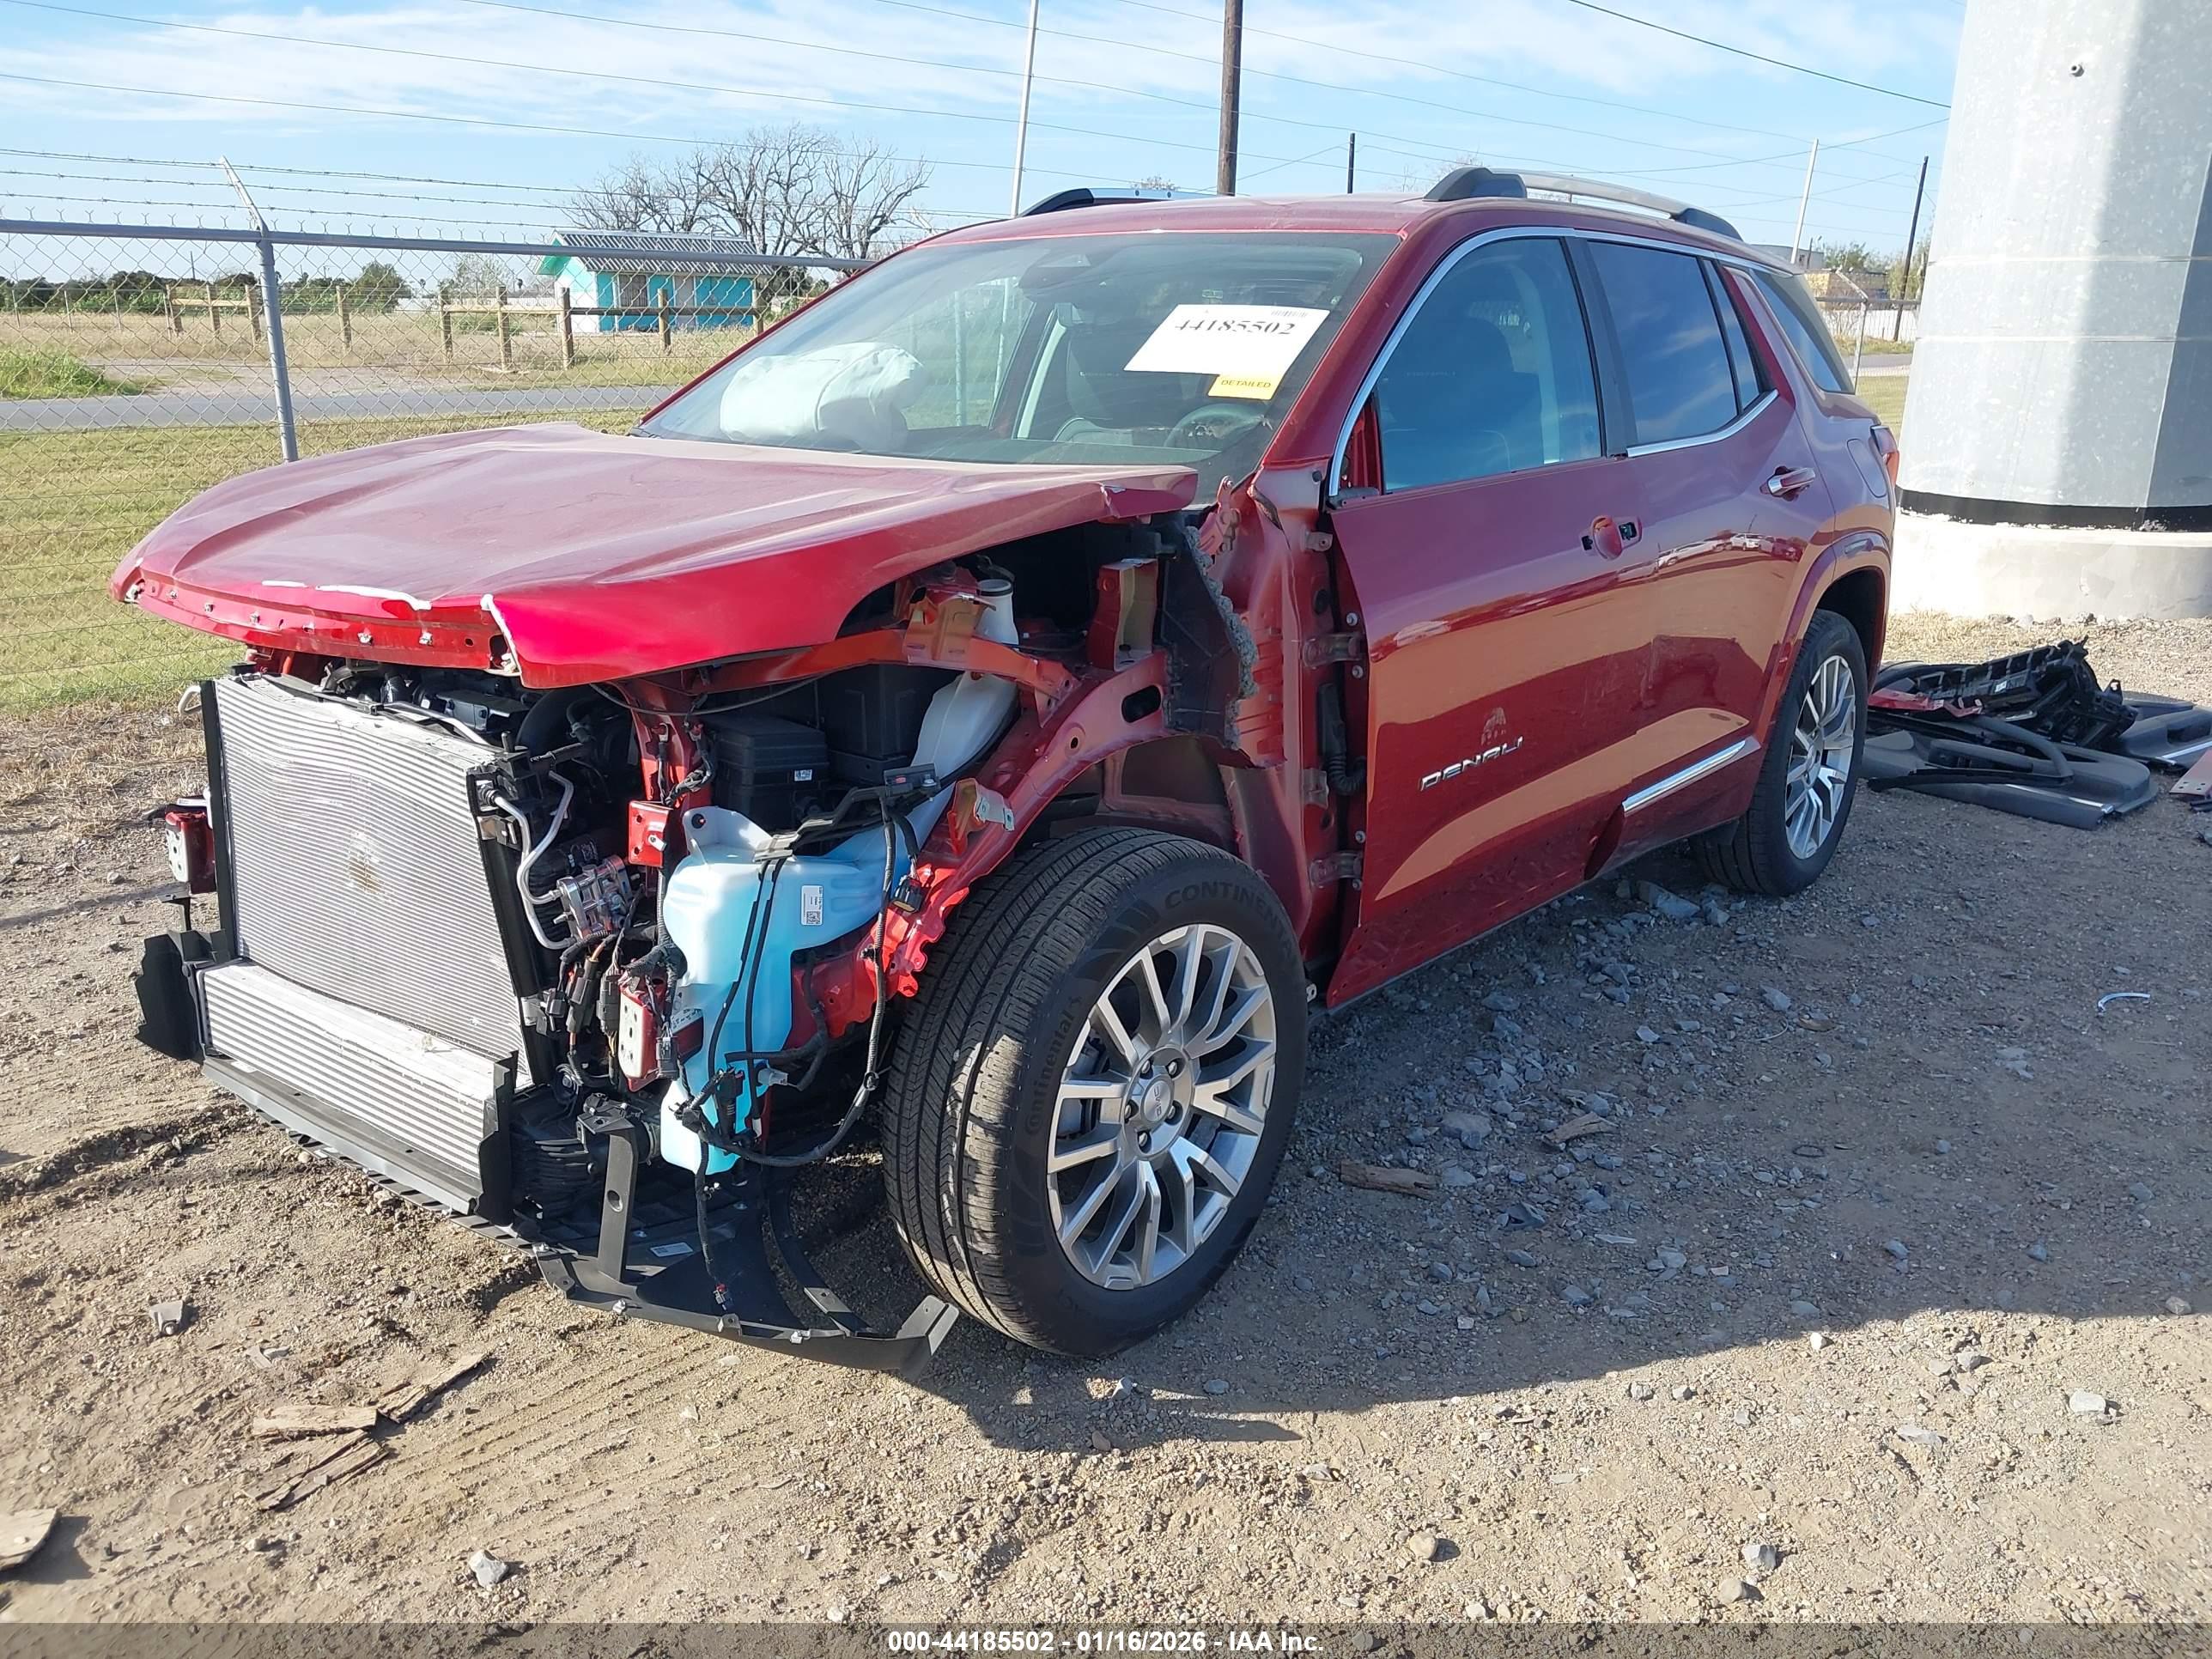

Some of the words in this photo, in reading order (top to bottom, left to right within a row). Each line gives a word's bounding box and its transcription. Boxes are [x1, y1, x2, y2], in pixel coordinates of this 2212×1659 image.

[1175, 319, 1296, 335] 44185502
[1221, 380, 1271, 388] DETAILED
[1419, 736, 1523, 791] DENALI
